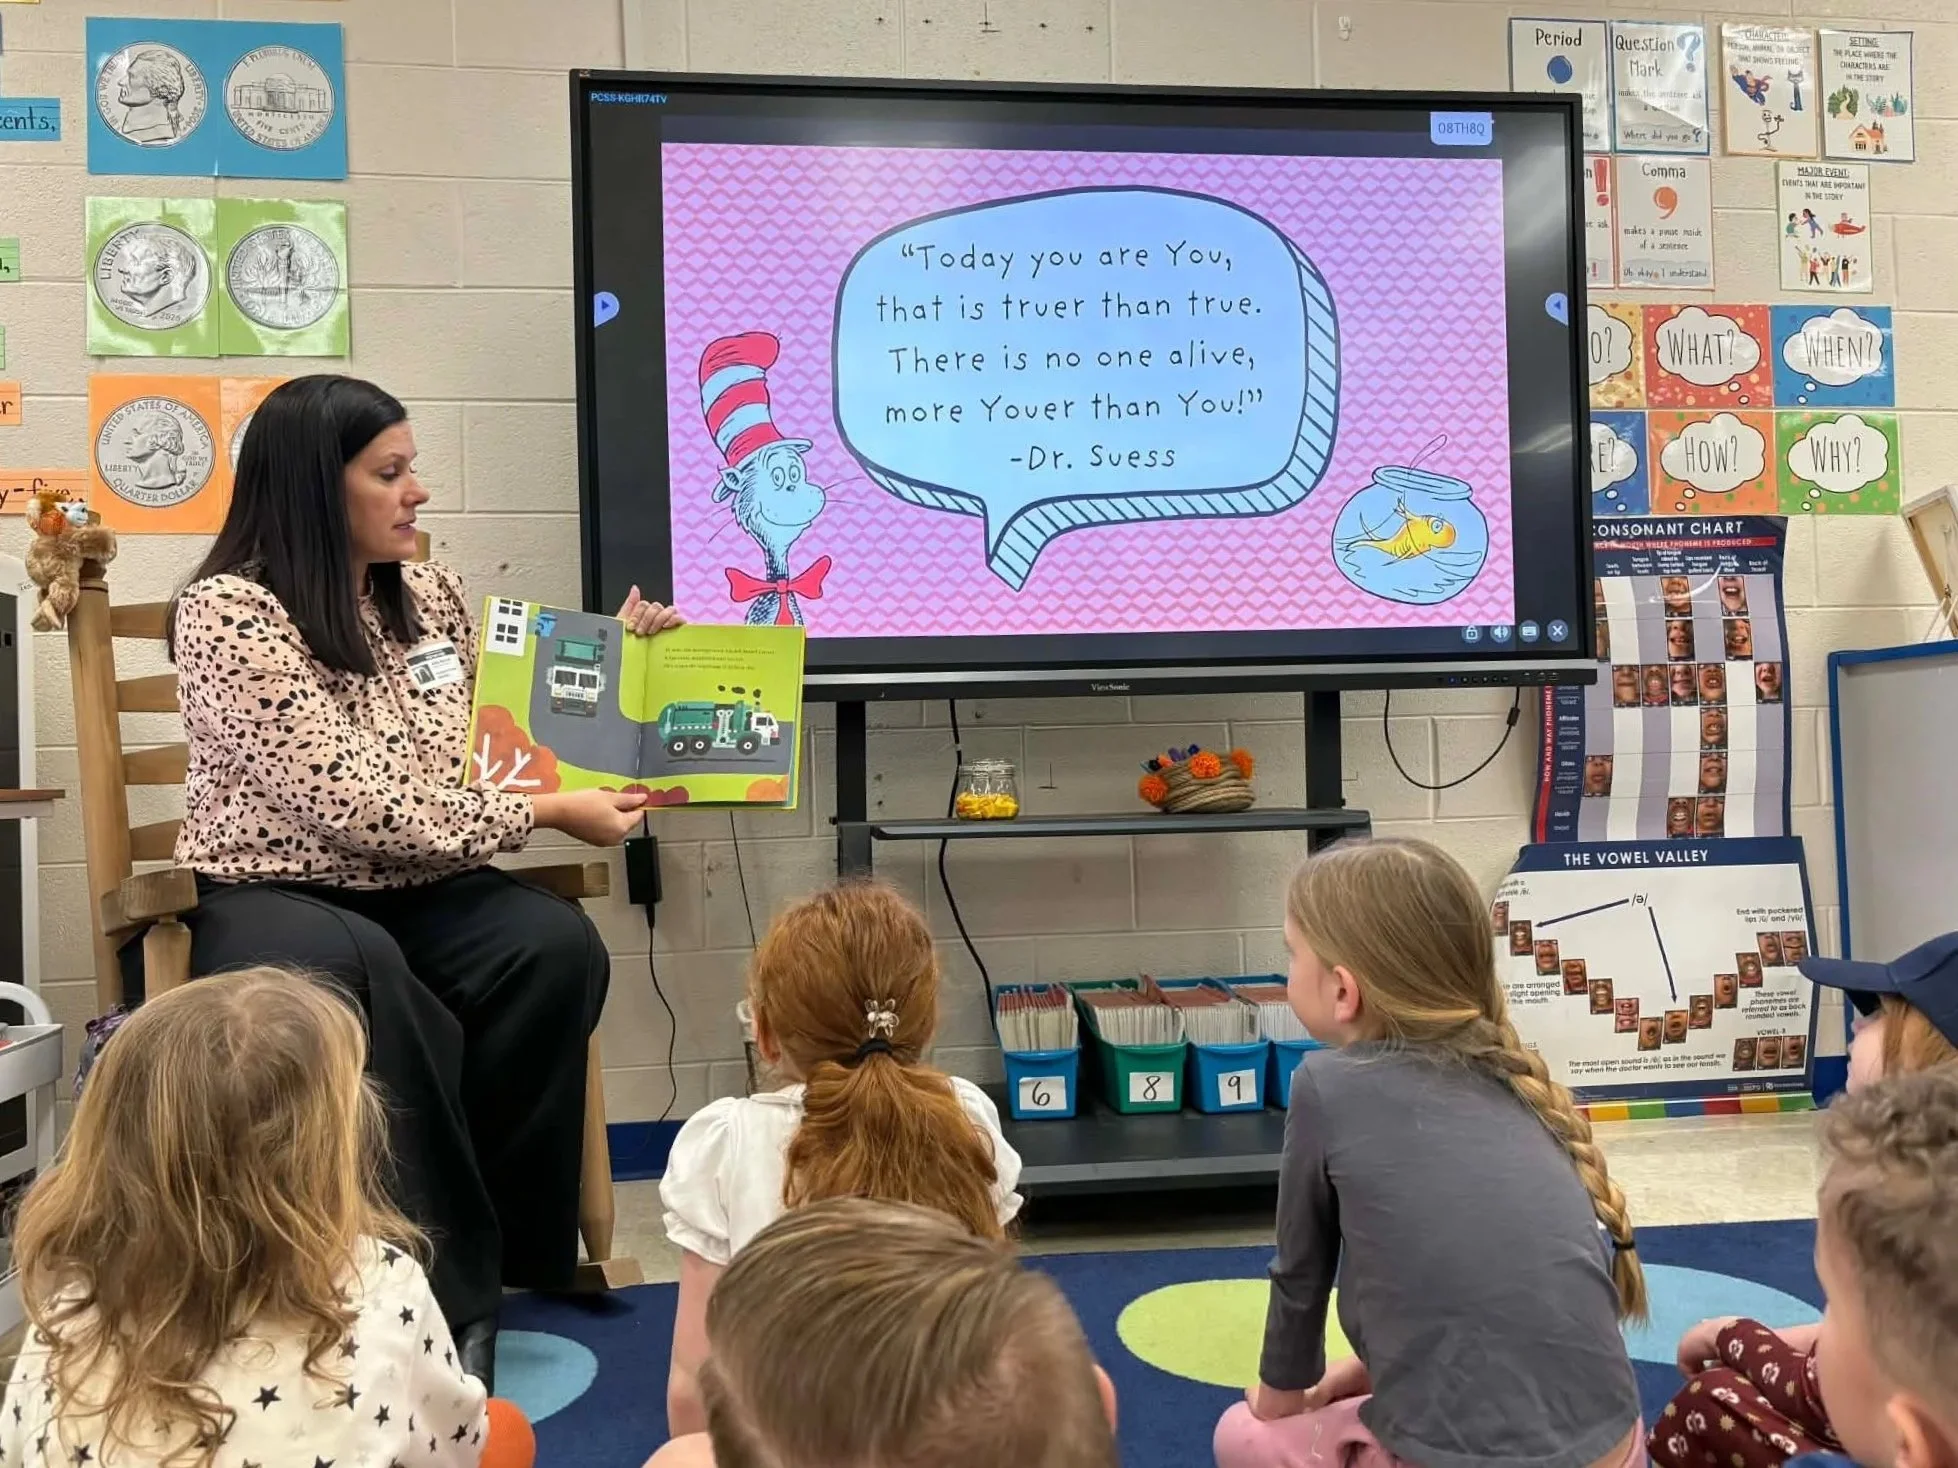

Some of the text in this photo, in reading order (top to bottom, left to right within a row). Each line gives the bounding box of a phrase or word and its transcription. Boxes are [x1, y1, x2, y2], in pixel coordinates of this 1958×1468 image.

[1535, 27, 1582, 46] Period
[1615, 34, 1674, 52] Question
[1844, 49, 1862, 58] PLACE
[1630, 59, 1664, 78] Mark
[1641, 163, 1686, 179] Comma
[1797, 166, 1823, 177] MAJOR
[1782, 178, 1866, 190] EVENTS THAT ARE IMPORTANT
[1805, 192, 1844, 201] IN THE STORY
[1624, 225, 1647, 235] makes
[99, 228, 140, 280] LIBERTY
[901, 240, 1233, 279] “Today you are You,
[877, 290, 1261, 322] that is truer than true.
[1591, 326, 1613, 365] O?
[1667, 328, 1735, 366] WHAT?
[1803, 330, 1874, 369] WHEN?
[889, 339, 1255, 374] There is no one alive,
[886, 388, 1263, 424] more Youer than You!”
[101, 400, 209, 450] UNITED STATES OF AMERICA
[1010, 445, 1176, 470] -Dr. Suess
[1684, 436, 1738, 474] HOW?
[1810, 436, 1862, 474] WHY?
[105, 464, 140, 473] LIBERTY
[113, 478, 198, 502] QUARTER DOLLAR
[1690, 520, 1744, 535] CHART
[1712, 538, 1752, 547] PRODUCED
[1545, 728, 1553, 744] WAY
[1545, 746, 1553, 762] AND
[1563, 849, 1709, 866] THE VOWEL VALLEY
[1526, 981, 1560, 990] arranged
[1529, 988, 1561, 997] opening
[1741, 1005, 1770, 1013] referred
[1745, 1012, 1775, 1020] rounded
[1571, 1068, 1583, 1076] say
[1585, 1066, 1604, 1074] when
[1605, 1065, 1618, 1073] the
[1619, 1064, 1641, 1072] doctor
[1621, 1057, 1642, 1065] sound
[1031, 1080, 1051, 1106] 6
[1142, 1075, 1161, 1101] 8
[1227, 1075, 1242, 1101] 9
